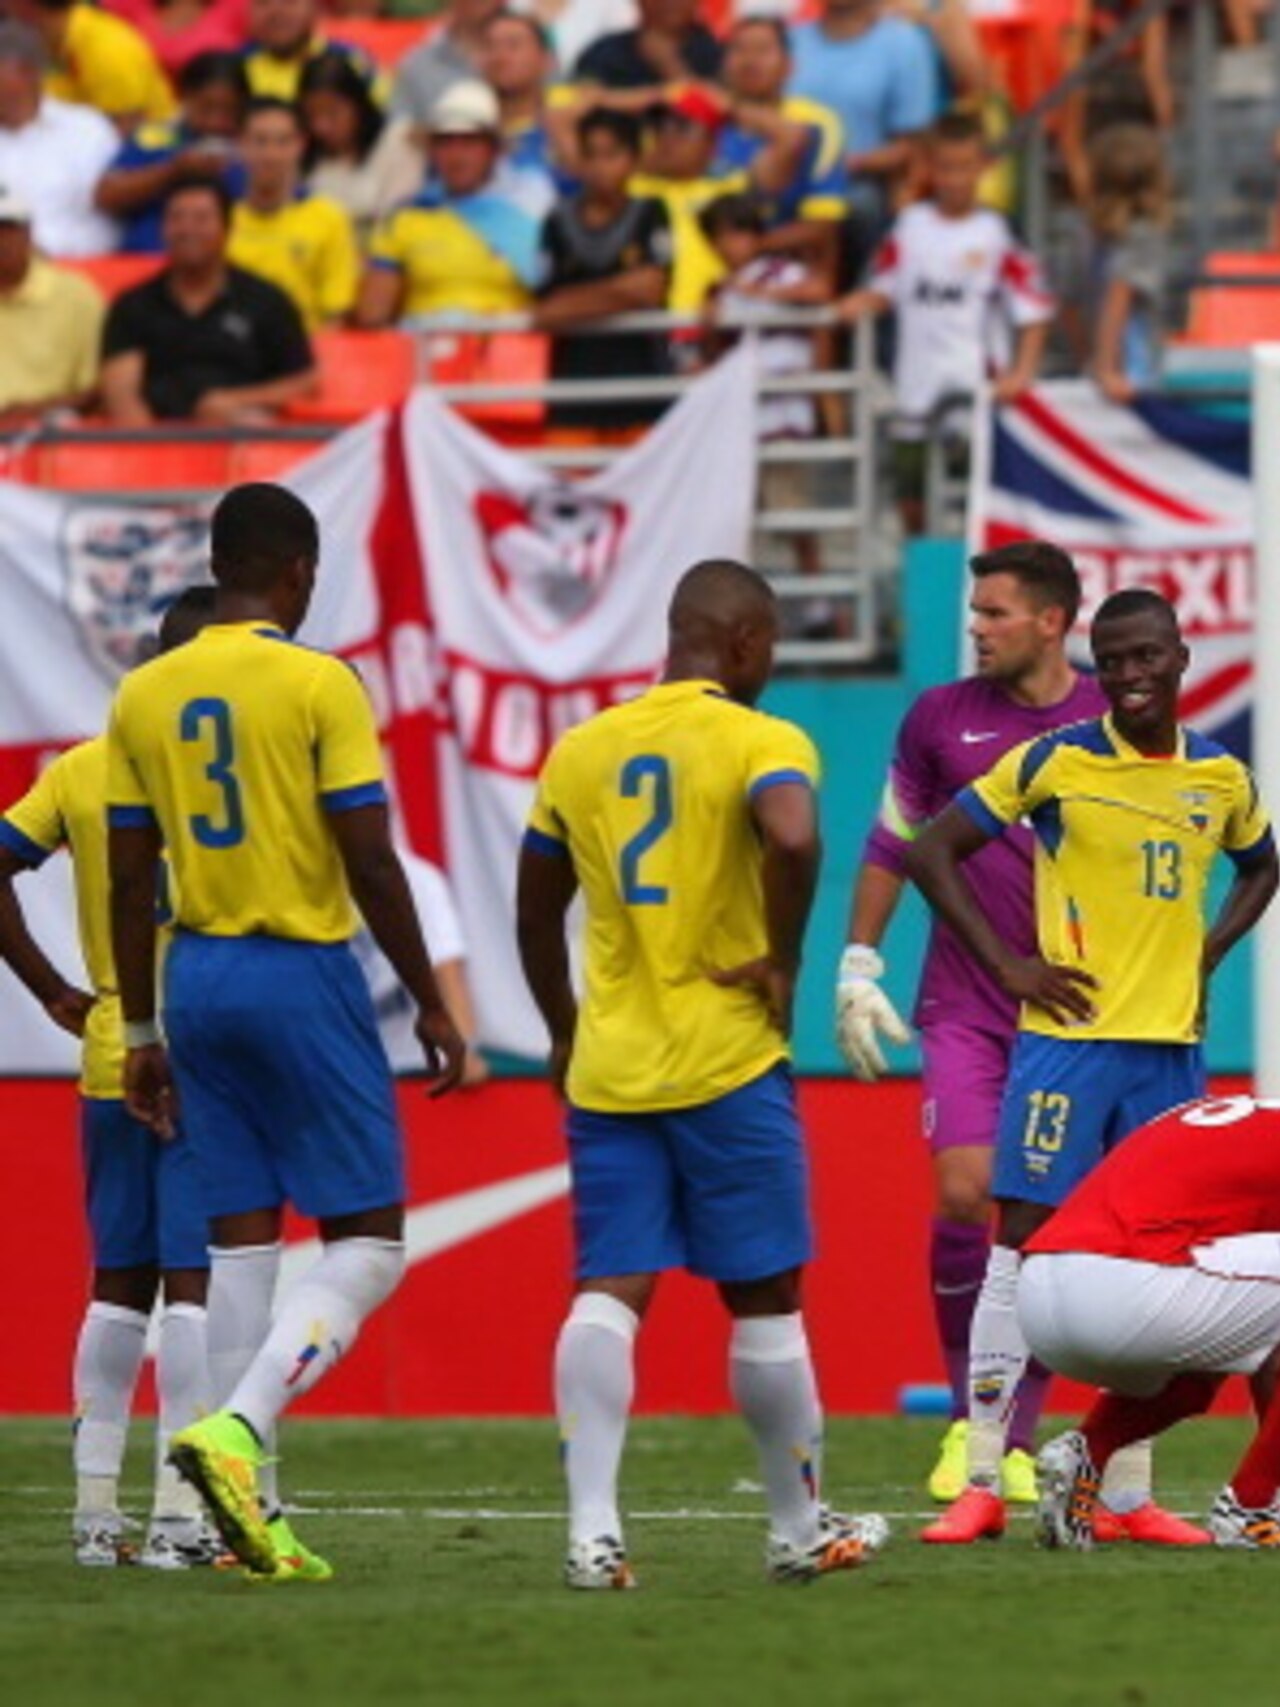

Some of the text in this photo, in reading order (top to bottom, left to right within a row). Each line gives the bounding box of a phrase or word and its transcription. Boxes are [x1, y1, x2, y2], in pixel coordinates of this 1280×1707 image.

[180, 696, 245, 849] 3
[619, 753, 673, 906] 2
[1141, 839, 1182, 902] 13
[1023, 1090, 1071, 1153] 13
